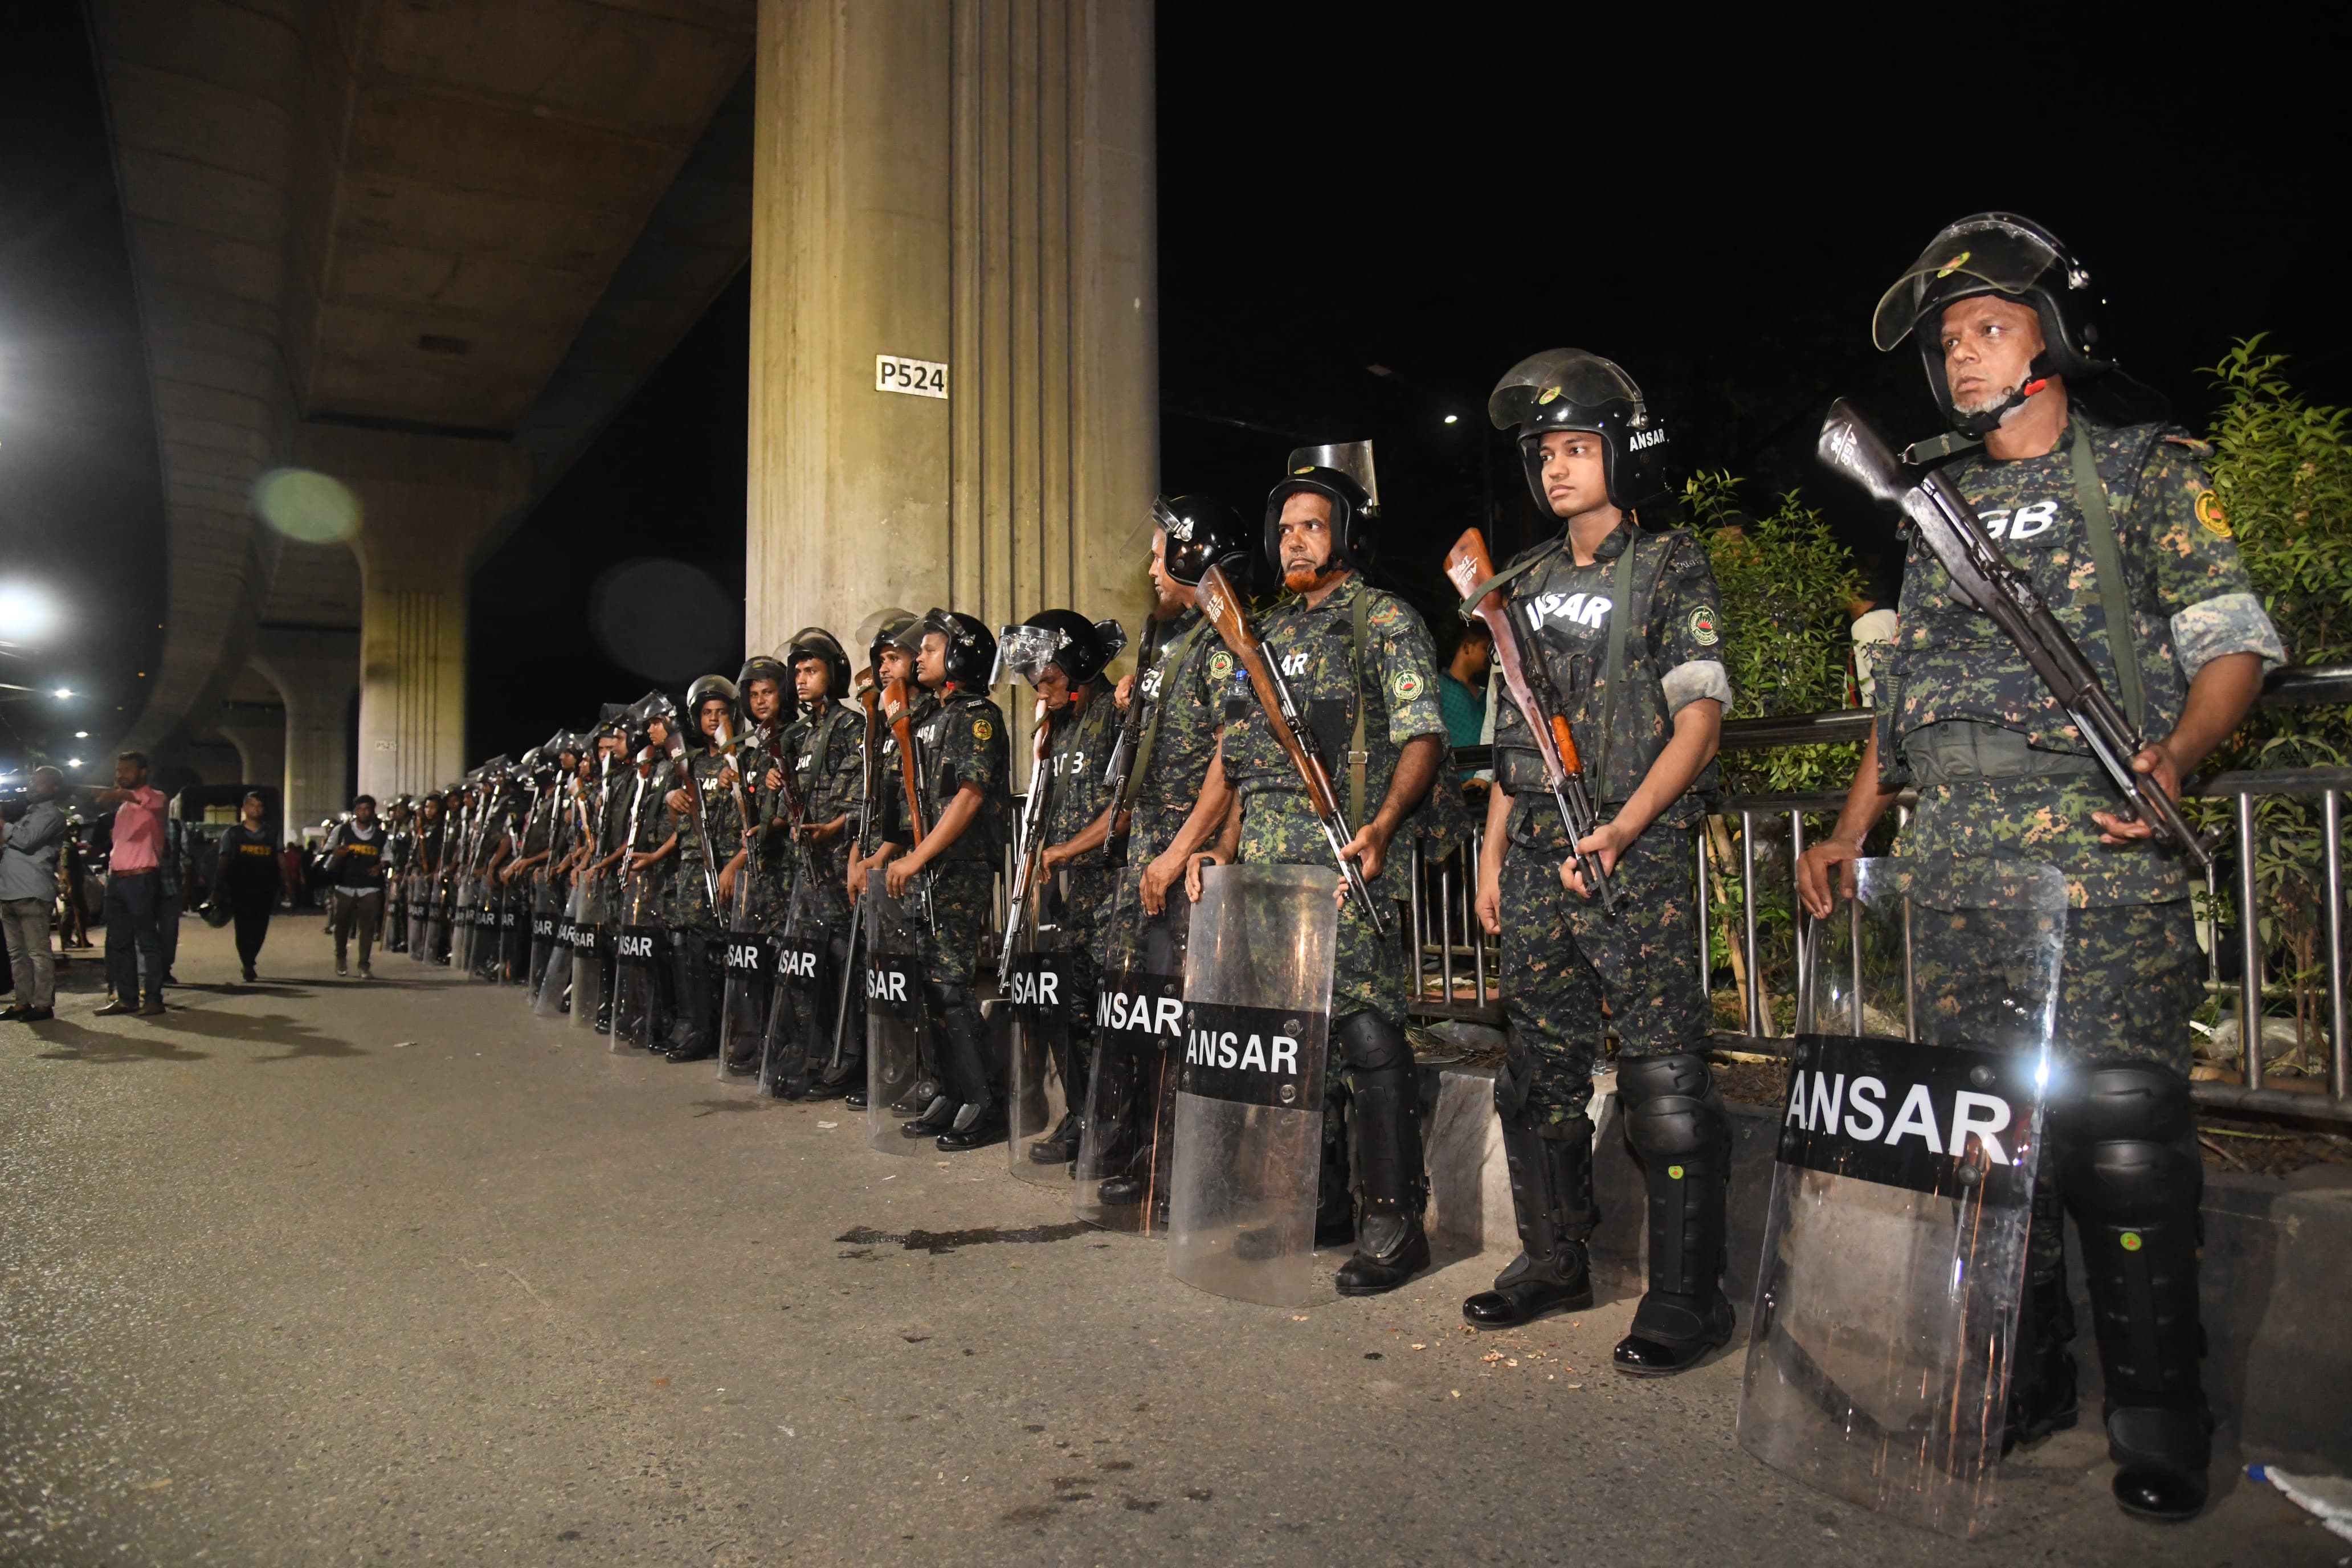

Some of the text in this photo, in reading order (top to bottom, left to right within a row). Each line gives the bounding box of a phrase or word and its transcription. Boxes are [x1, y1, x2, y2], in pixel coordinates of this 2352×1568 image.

[881, 362, 944, 392] P524
[1630, 428, 1665, 452] ANSAR
[728, 944, 758, 969] SAR
[868, 968, 908, 1002] SAR
[1185, 1028, 1298, 1075] ANSAR
[1785, 1069, 2012, 1166] ANSAR
